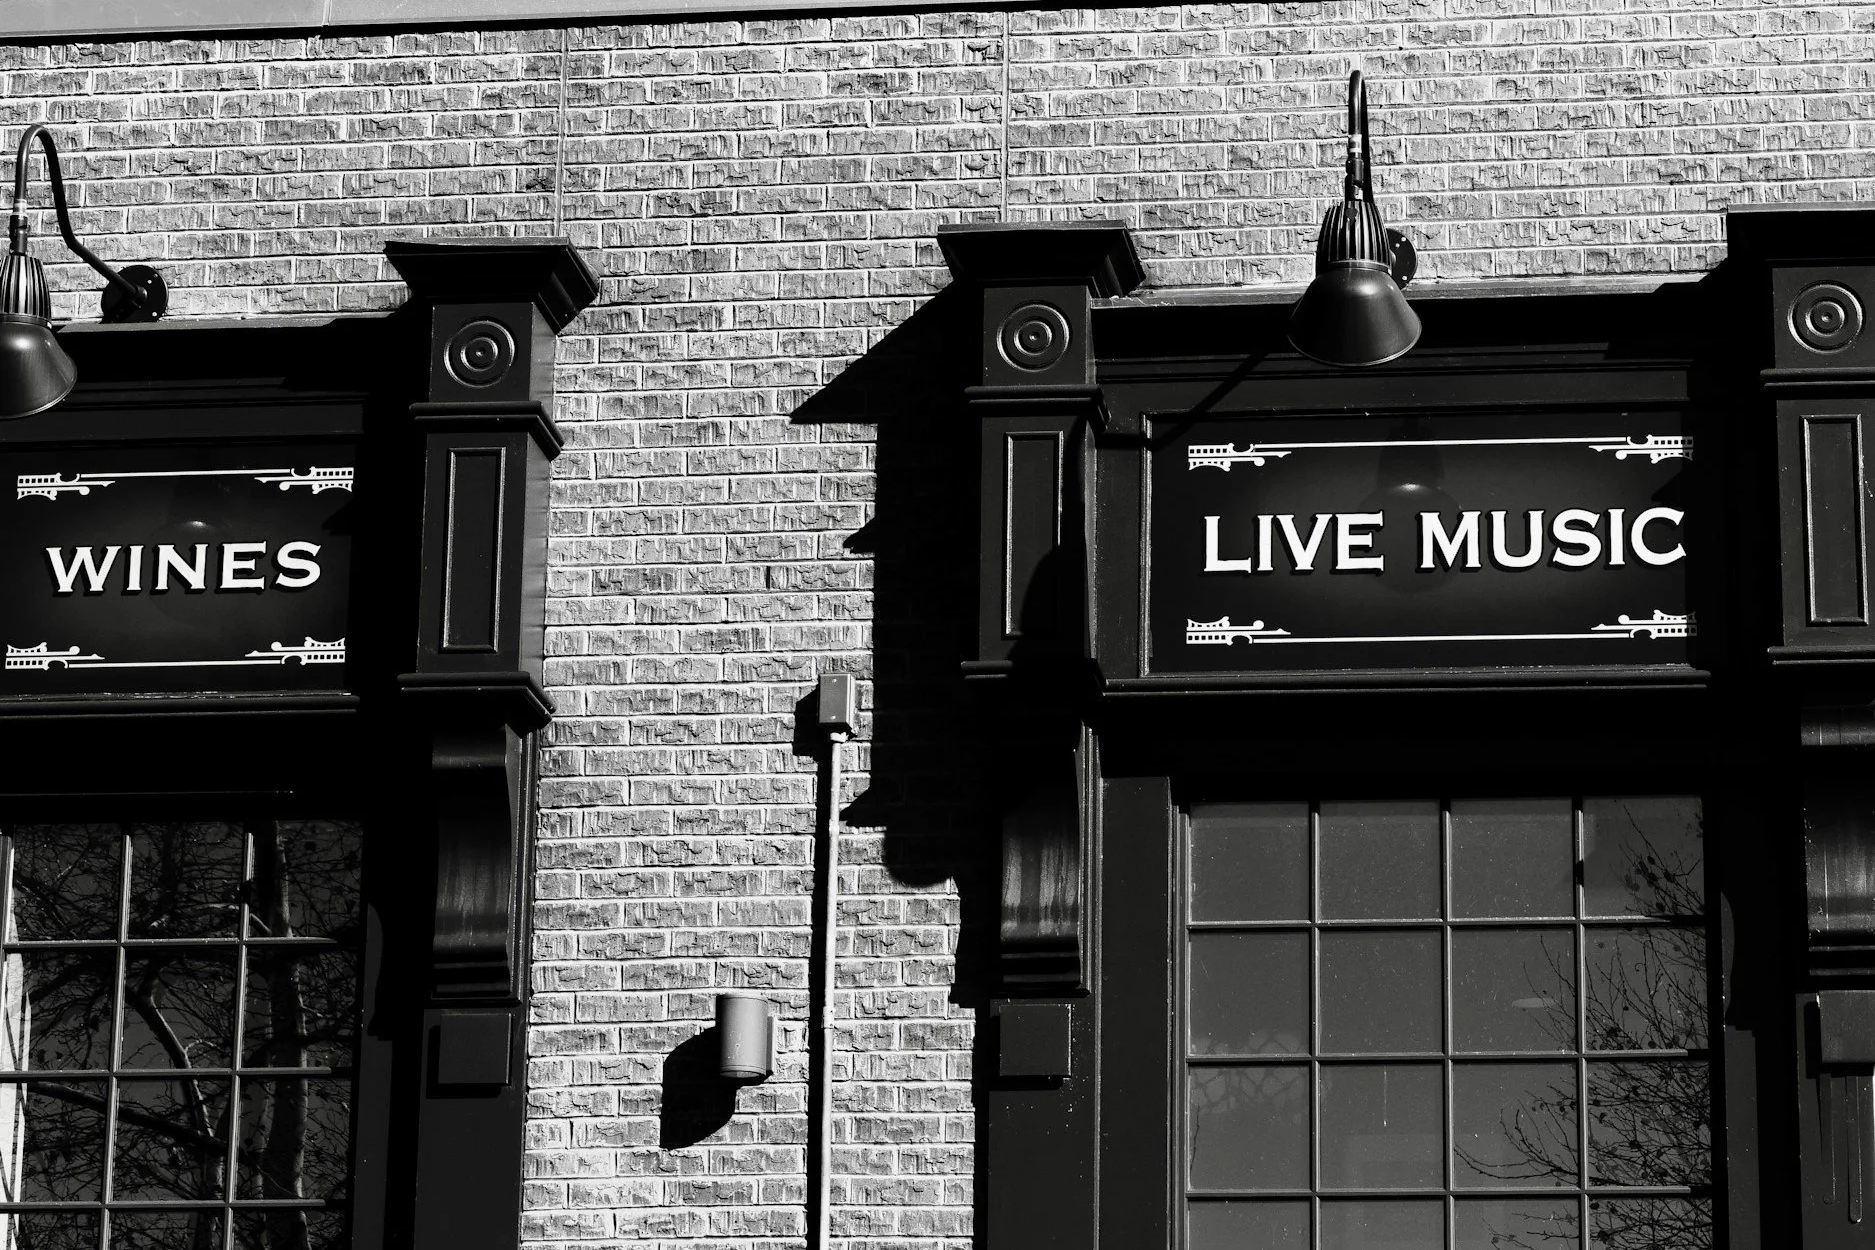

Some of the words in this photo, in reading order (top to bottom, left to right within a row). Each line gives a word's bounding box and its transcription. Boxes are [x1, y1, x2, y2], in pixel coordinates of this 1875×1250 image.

[45, 540, 322, 592] WINES
[1203, 511, 1384, 574] LIVE
[1419, 508, 1687, 569] MUSIC
